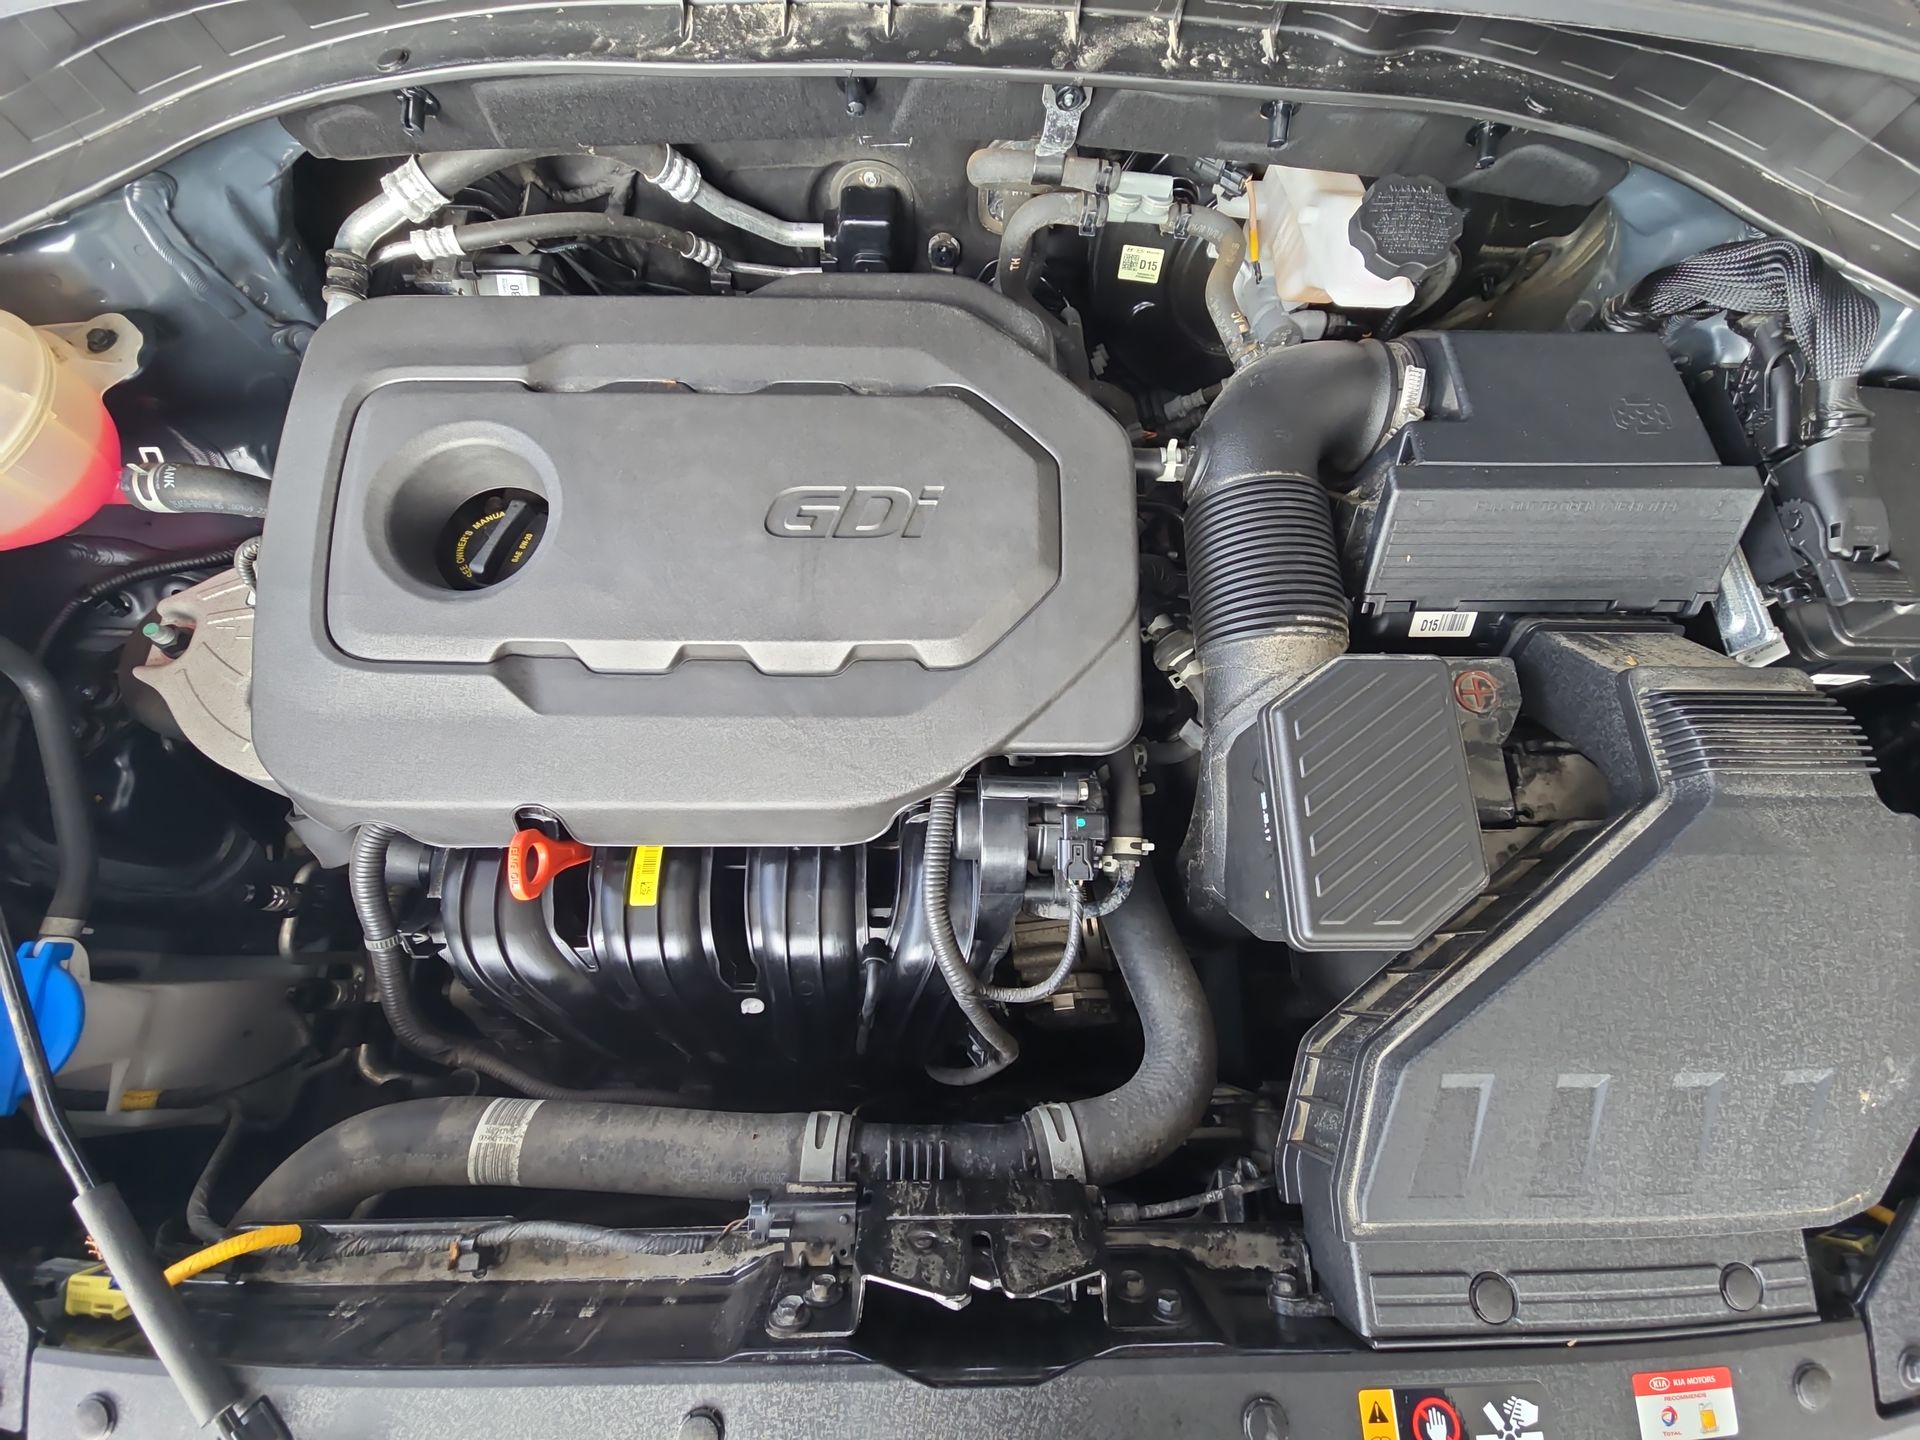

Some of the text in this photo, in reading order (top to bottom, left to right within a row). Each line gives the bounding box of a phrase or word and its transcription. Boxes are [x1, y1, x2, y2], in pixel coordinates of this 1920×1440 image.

[1140, 259, 1158, 272] D15
[160, 464, 176, 489] ANK
[763, 485, 945, 538] GDi
[456, 511, 506, 578] SEE OWNER'S MANUA
[1420, 619, 1439, 632] D15
[510, 846, 519, 870] ENG
[1672, 1375, 1716, 1387] KIA MOTORS
